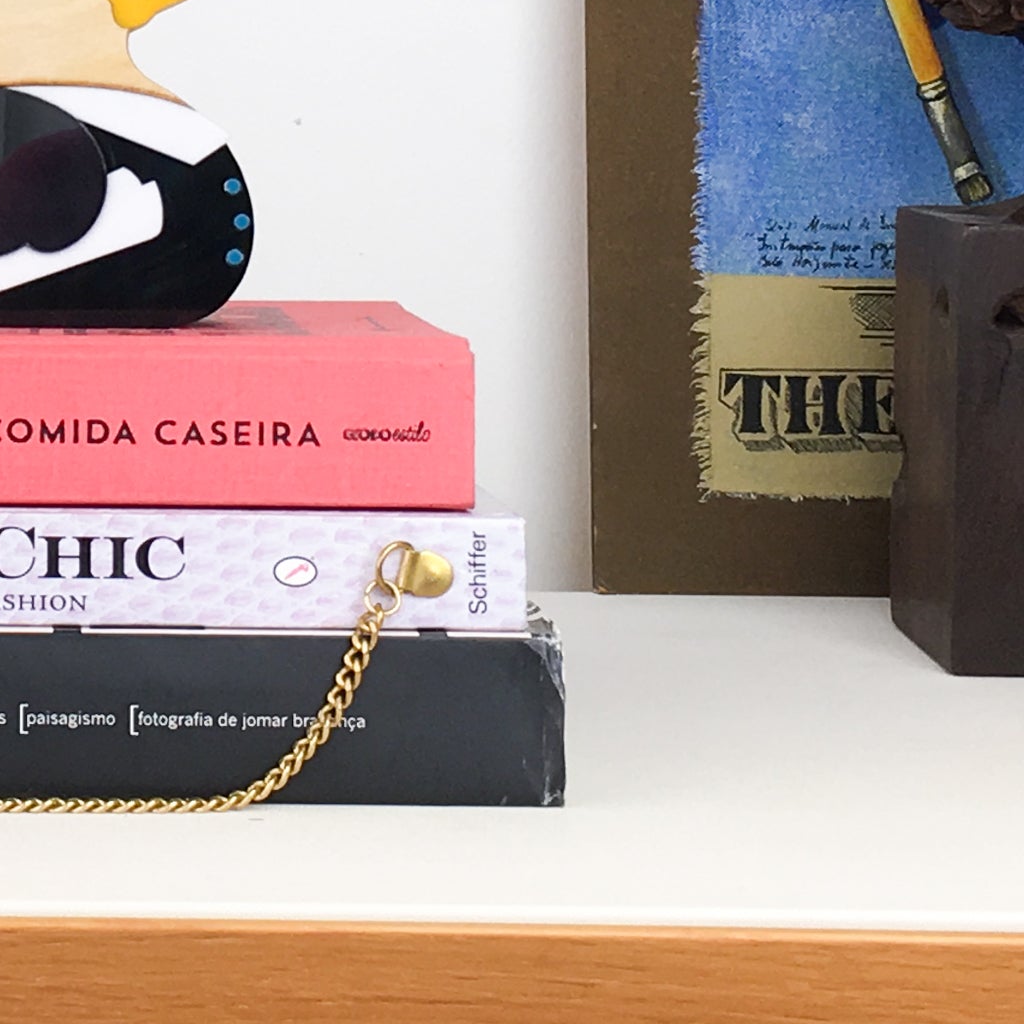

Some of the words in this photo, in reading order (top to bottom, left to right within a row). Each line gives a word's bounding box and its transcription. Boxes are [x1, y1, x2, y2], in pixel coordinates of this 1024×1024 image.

[155, 420, 320, 446] CASEIRA
[468, 531, 487, 614] Schiffer
[218, 713, 238, 727] de
[241, 713, 288, 731] jomar
